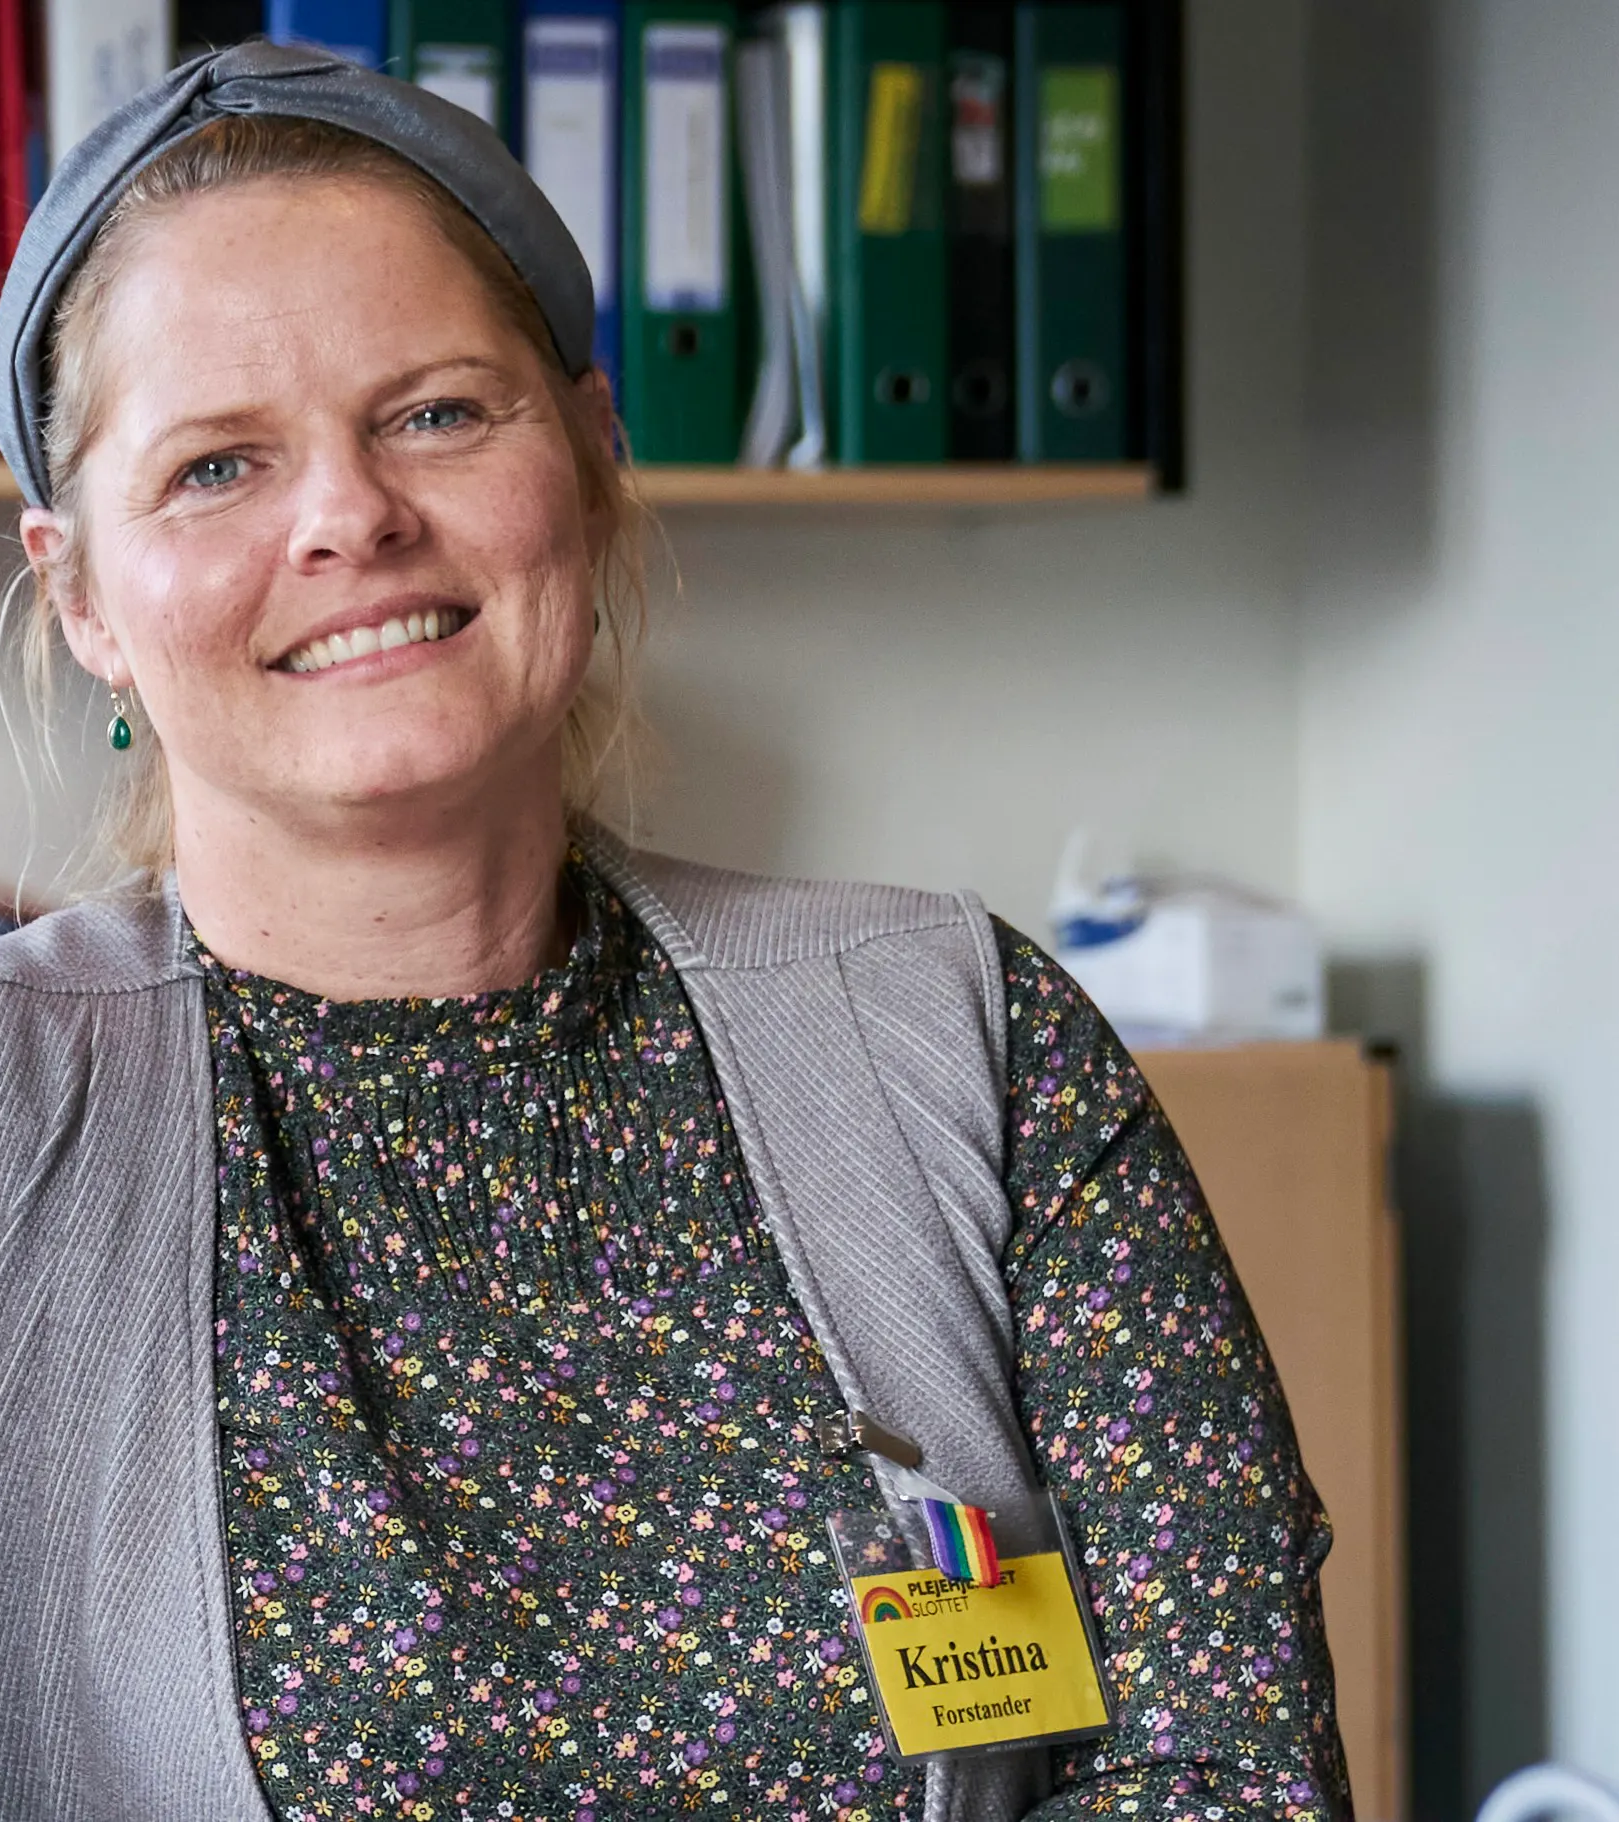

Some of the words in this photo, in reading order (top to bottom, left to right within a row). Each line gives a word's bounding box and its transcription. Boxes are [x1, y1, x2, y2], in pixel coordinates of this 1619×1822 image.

[907, 1569, 1016, 1598] PLEJEHJEET
[912, 1596, 969, 1618] SLOTTET
[896, 1635, 1049, 1690] Kristina
[932, 1695, 1032, 1727] Forstander
